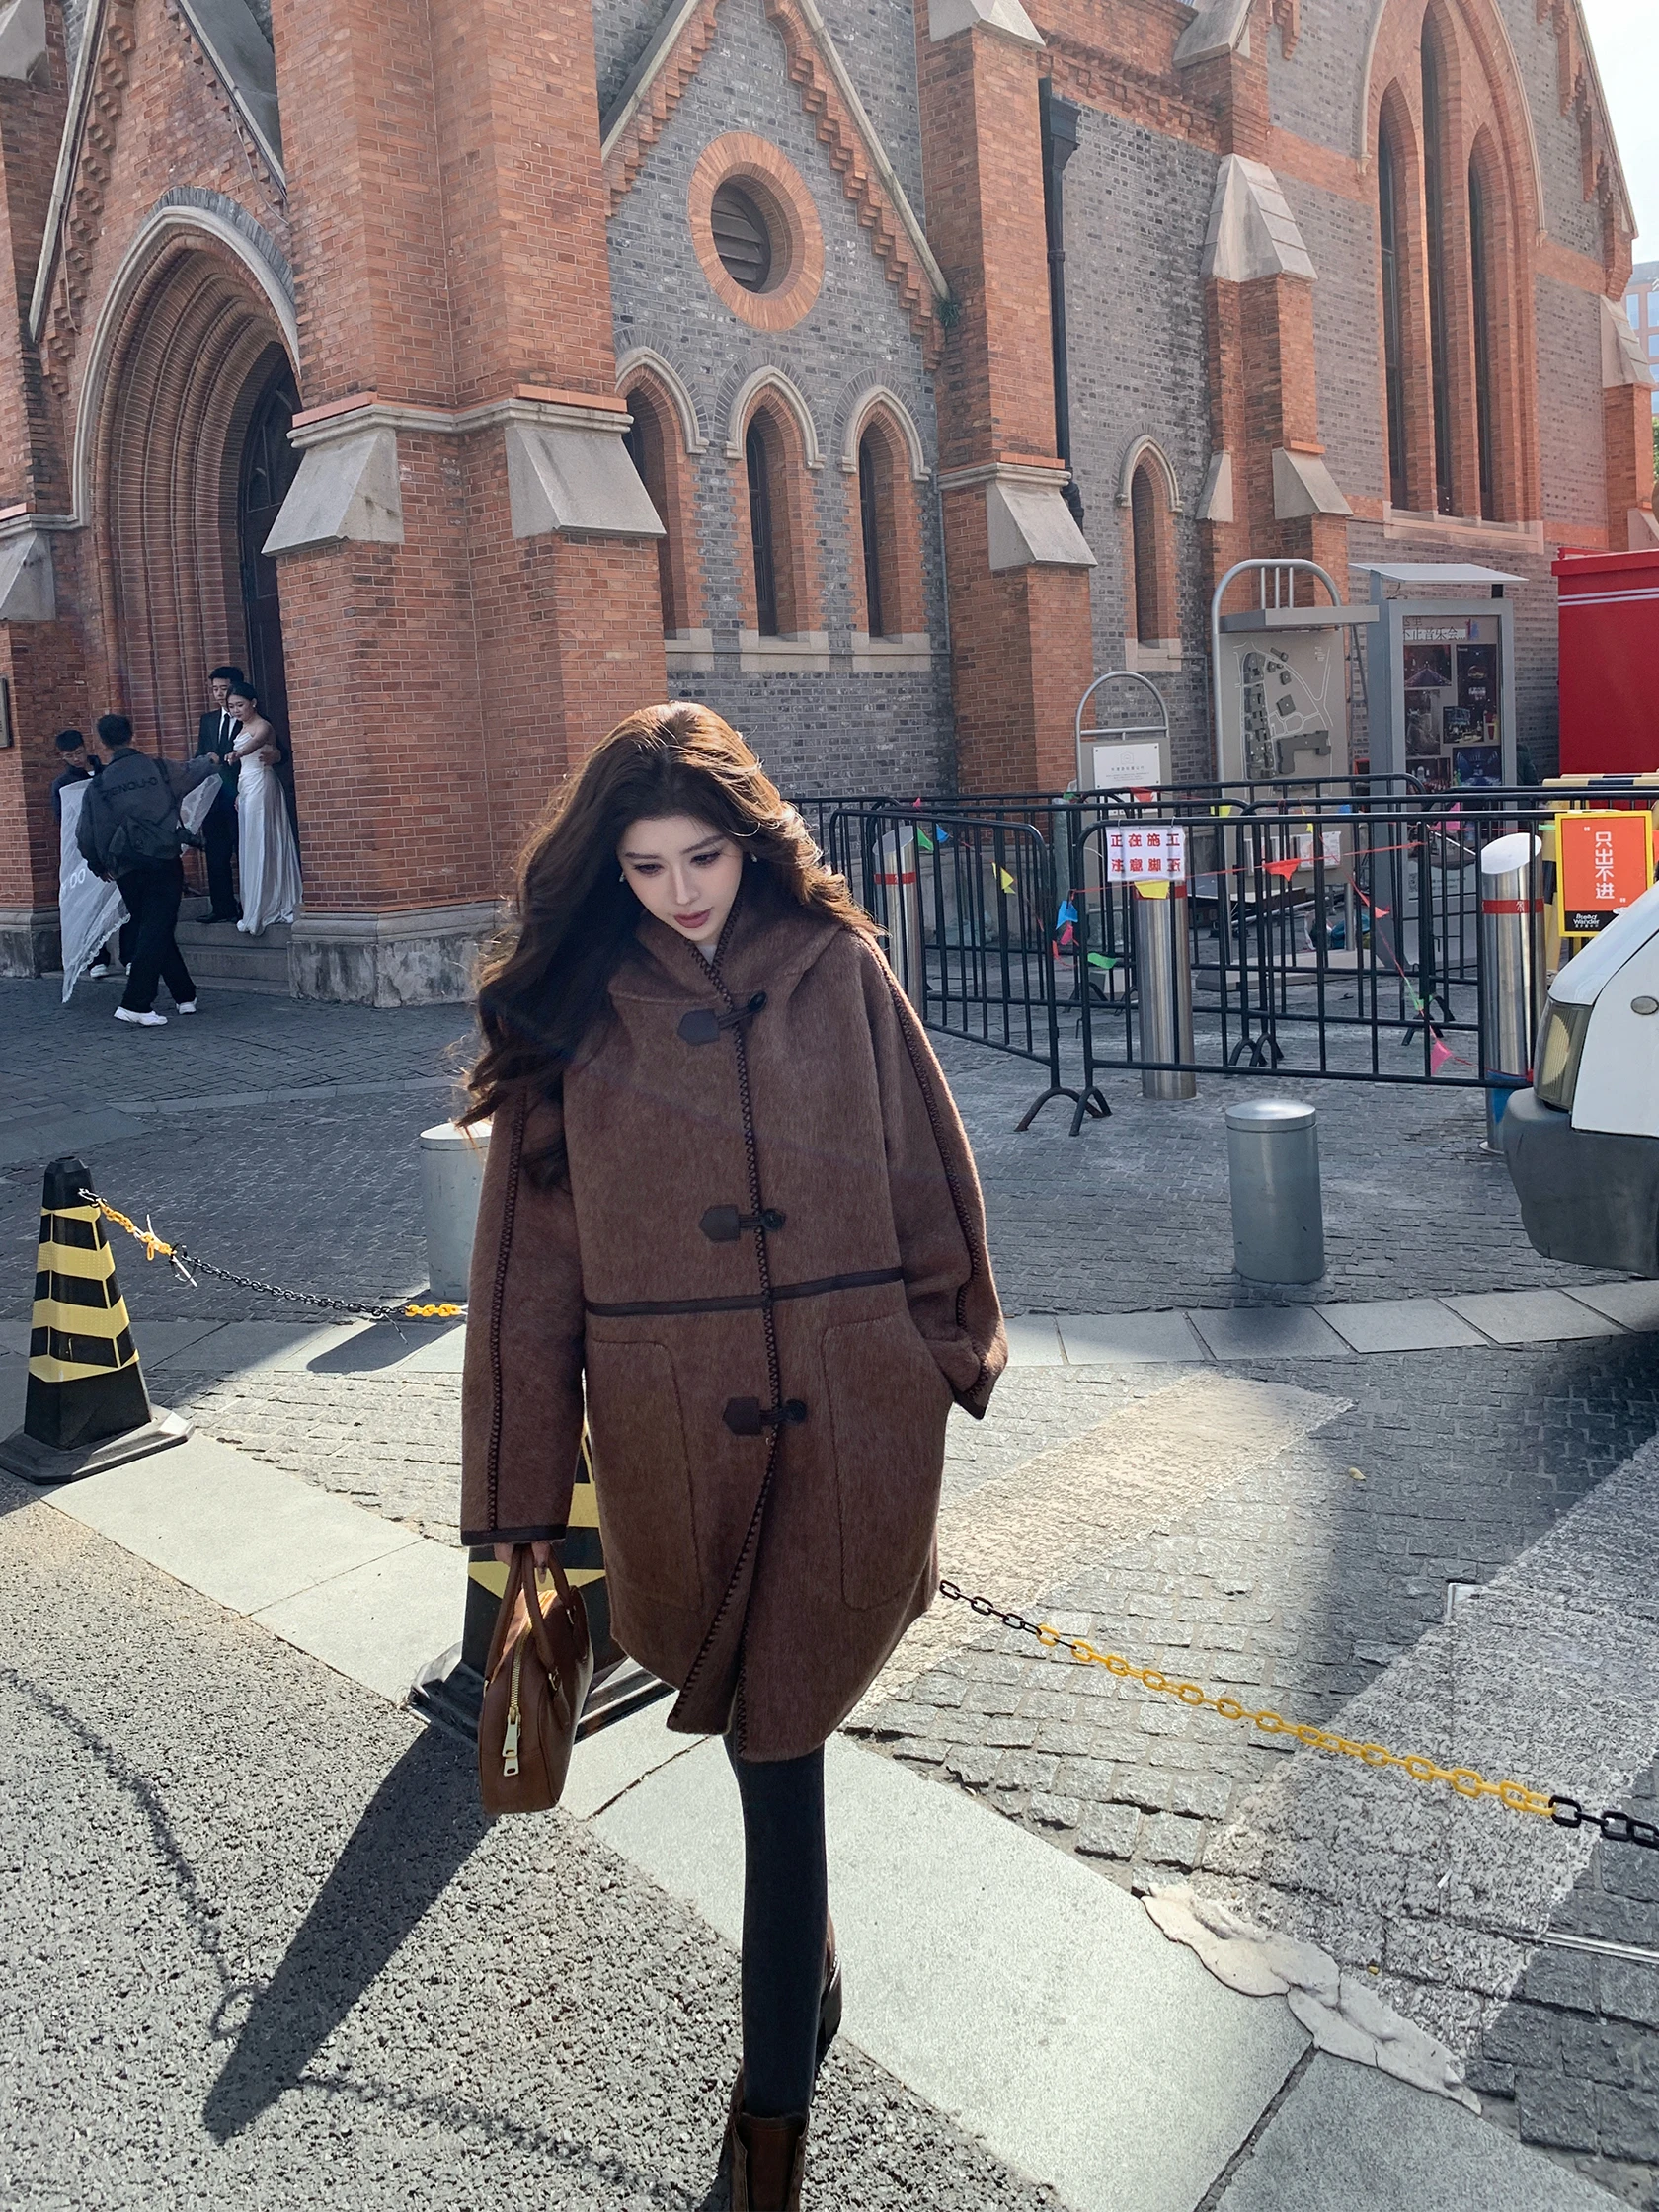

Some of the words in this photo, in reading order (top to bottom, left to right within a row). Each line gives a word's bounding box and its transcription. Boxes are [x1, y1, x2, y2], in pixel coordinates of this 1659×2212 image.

[1110, 833, 1180, 848] 正在施工
[1594, 831, 1616, 900] 只出不进
